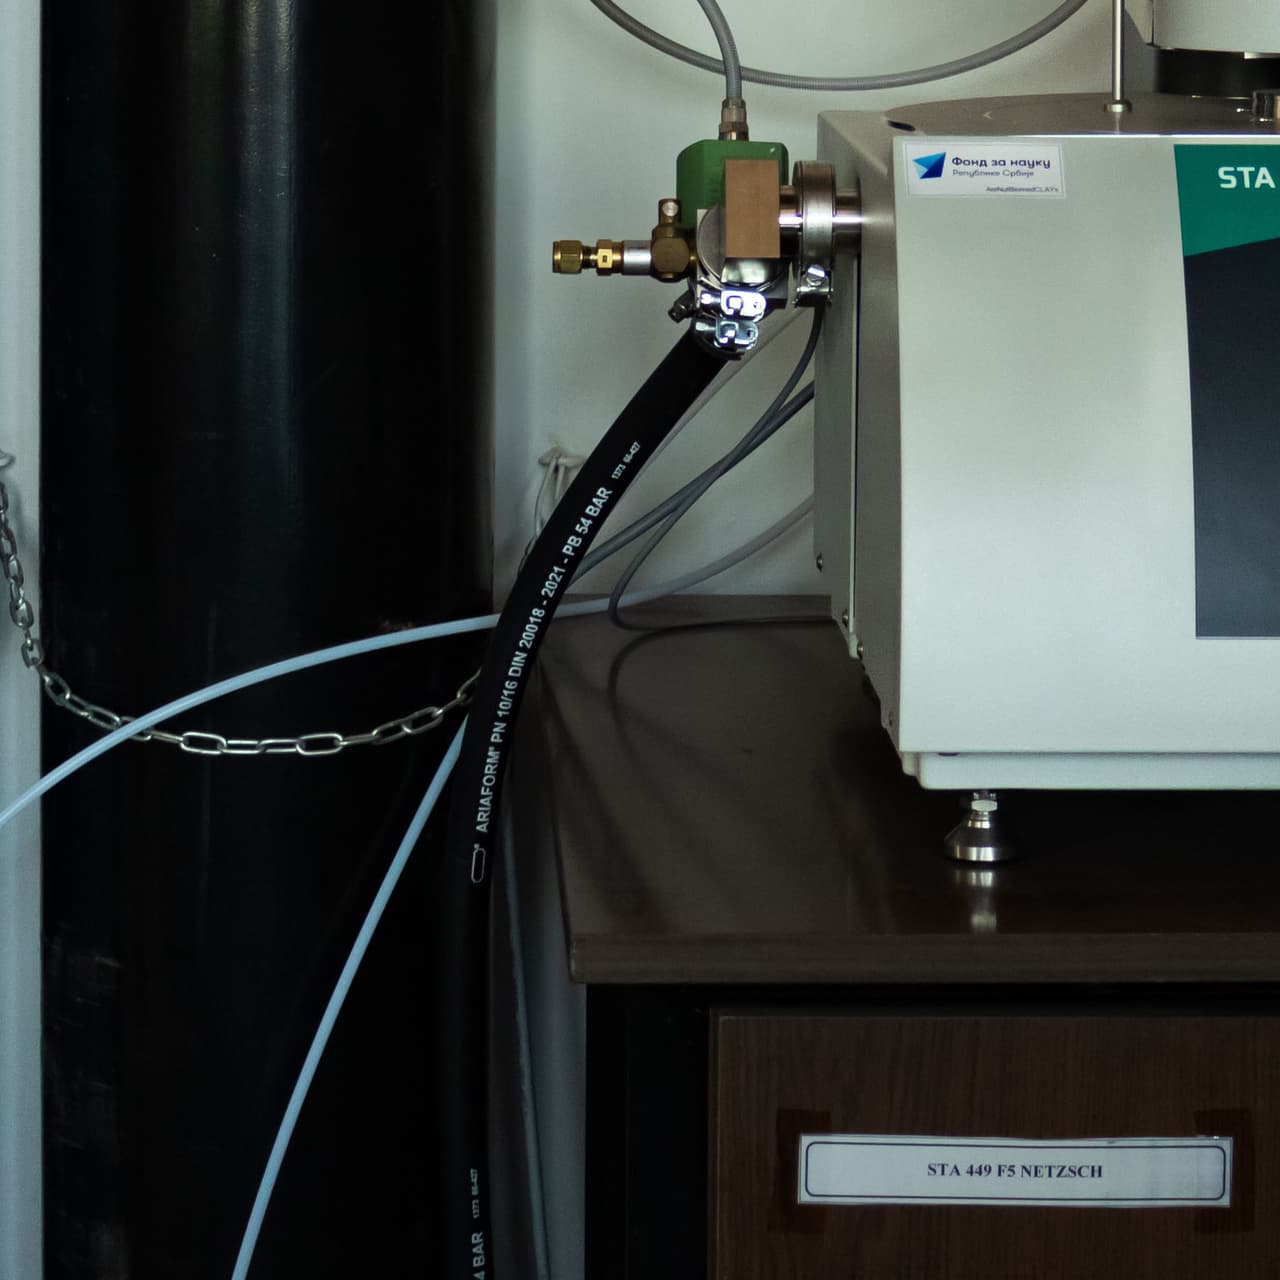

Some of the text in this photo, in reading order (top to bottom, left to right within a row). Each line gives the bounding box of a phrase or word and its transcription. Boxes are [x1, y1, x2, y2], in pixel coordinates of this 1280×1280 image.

[951, 156, 1051, 169] Фонд за науку
[1218, 167, 1276, 189] STA
[585, 487, 613, 517] BAR
[575, 517, 593, 535] 54
[562, 535, 582, 556] PB
[541, 565, 566, 598] 2021
[519, 608, 545, 649] 20018
[508, 651, 528, 677] DIN
[497, 680, 518, 717] 10/16
[490, 721, 507, 743] PN
[927, 1163, 1103, 1178] STA 449 F5 NETZSCH
[472, 1231, 485, 1268] BAR
